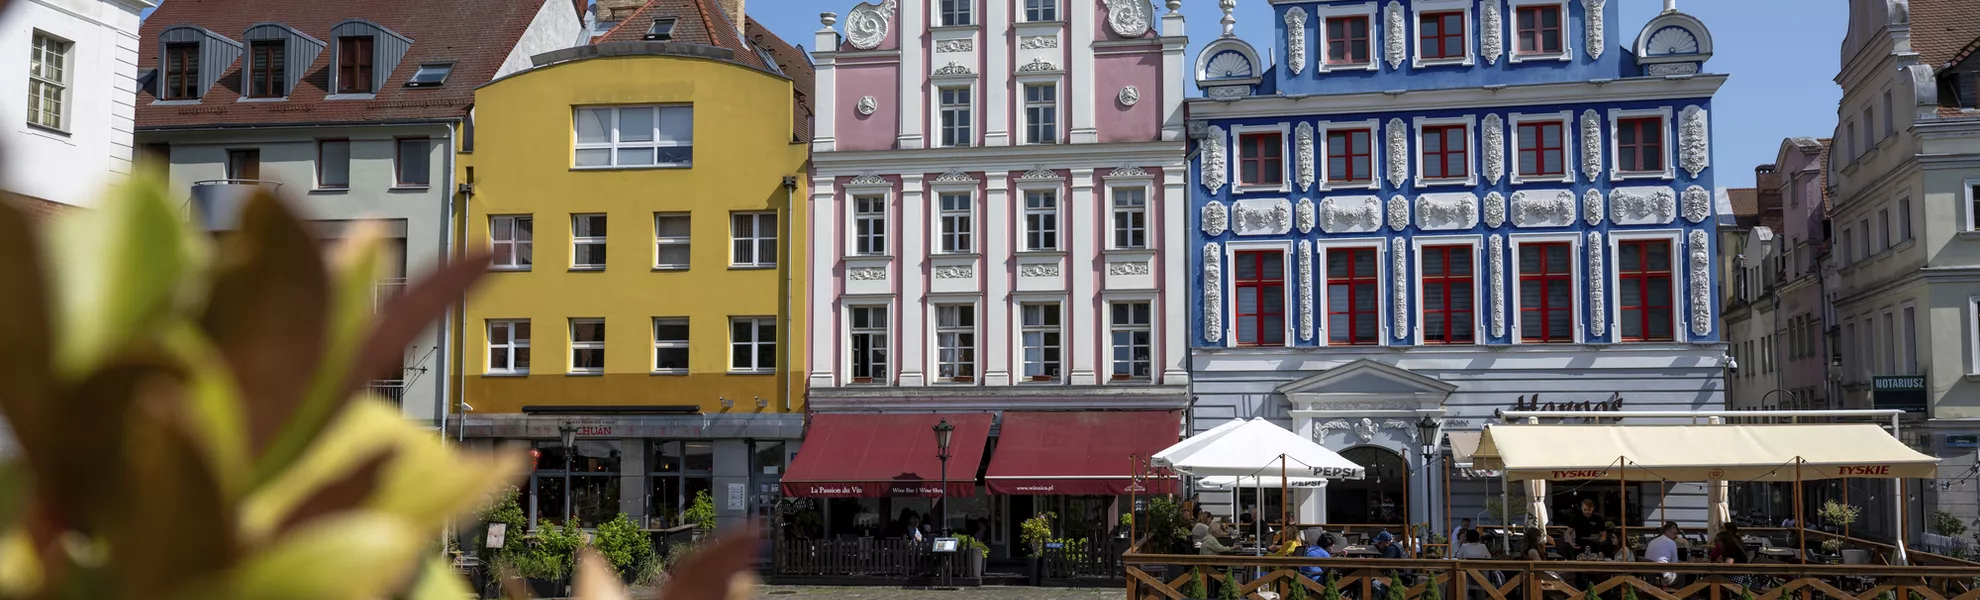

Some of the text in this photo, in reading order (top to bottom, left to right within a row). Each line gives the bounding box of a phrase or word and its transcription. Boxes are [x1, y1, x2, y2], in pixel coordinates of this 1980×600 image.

[1876, 378, 1924, 389] NOTARIUSZ
[1313, 467, 1356, 477] PEPSI
[1552, 470, 1603, 478] TYSKIE
[1838, 465, 1890, 475] TYSKIE
